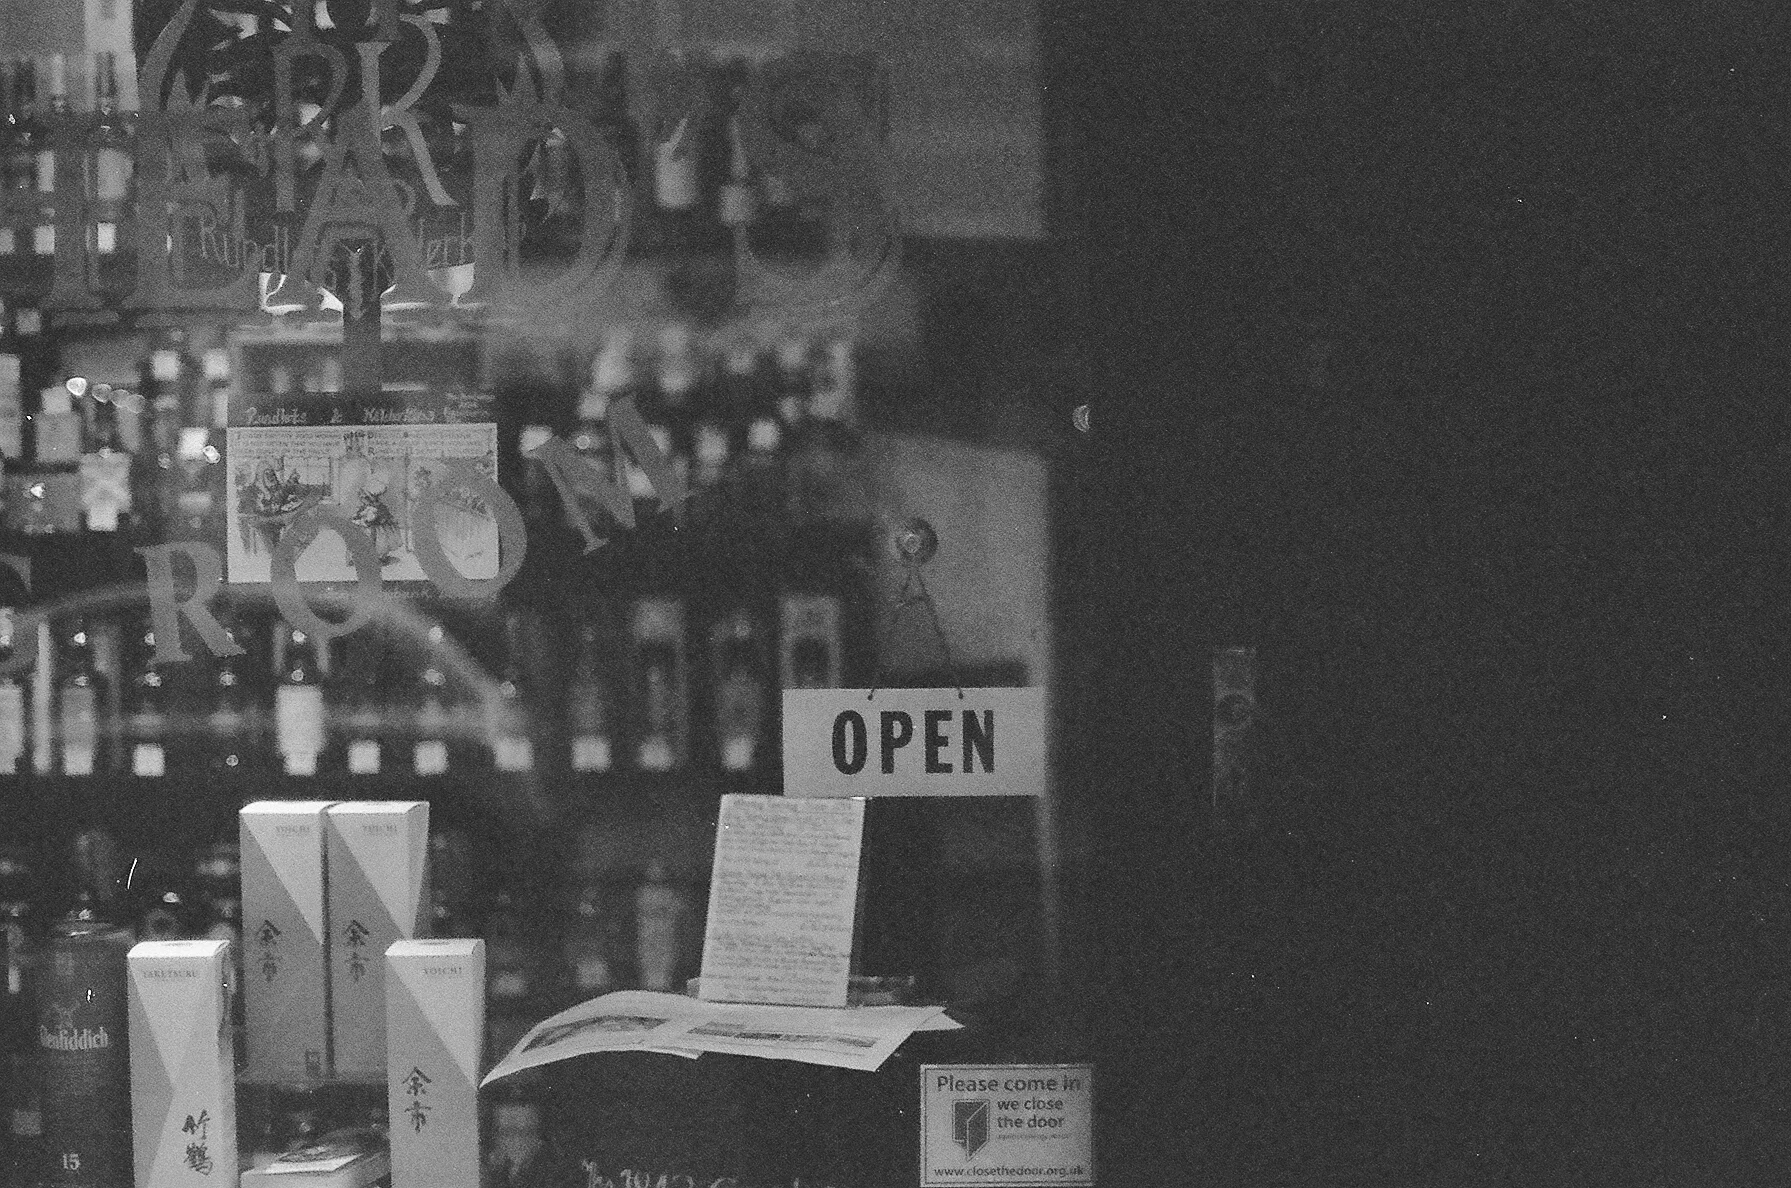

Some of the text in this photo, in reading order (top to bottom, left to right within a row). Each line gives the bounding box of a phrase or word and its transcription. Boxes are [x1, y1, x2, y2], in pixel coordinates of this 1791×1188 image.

[133, 391, 697, 664] ROOM
[832, 710, 995, 775] OPEN
[937, 1075, 1081, 1092] Please come in
[402, 1066, 432, 1134] 余市
[998, 1097, 1064, 1111] we close
[997, 1114, 1064, 1129] the door
[62, 1153, 81, 1170] 15
[934, 1165, 1084, 1177] www.closethedoor.org.uk
